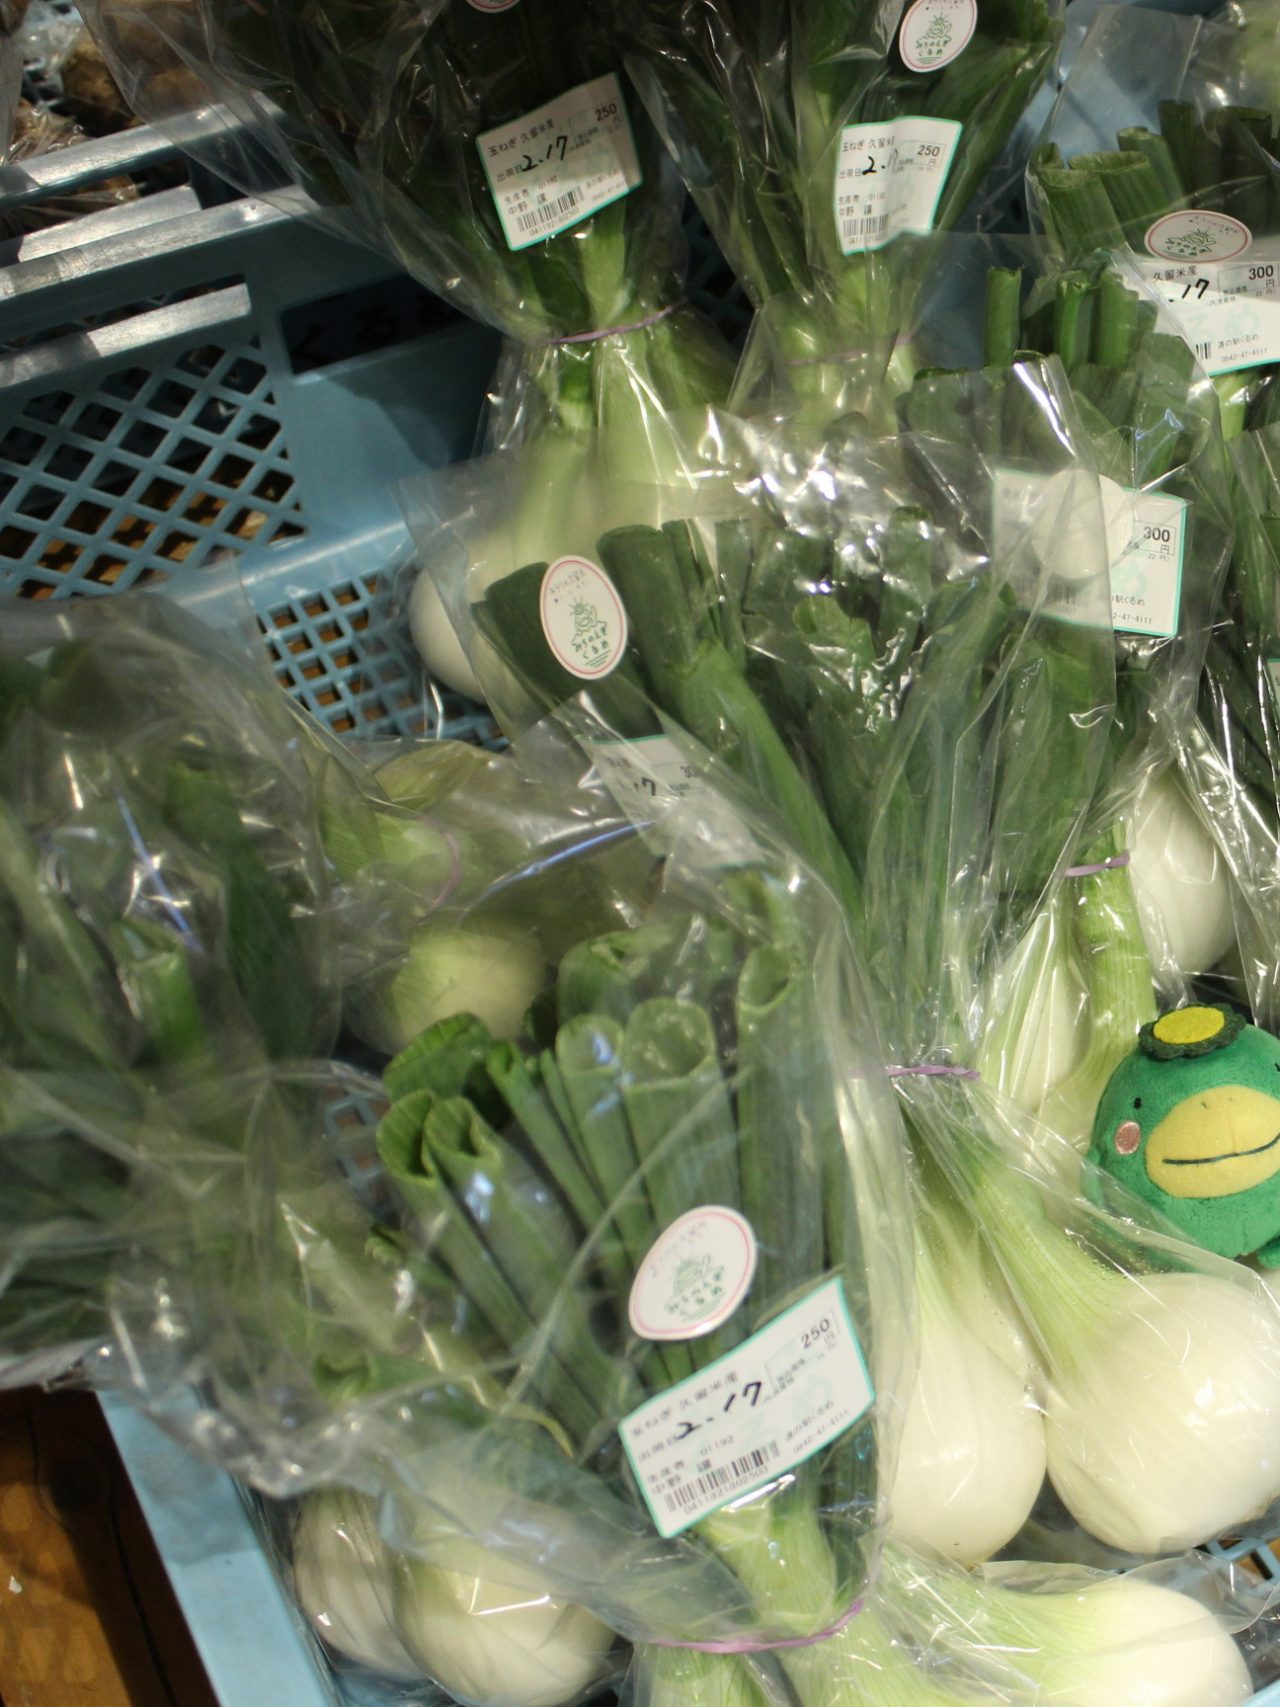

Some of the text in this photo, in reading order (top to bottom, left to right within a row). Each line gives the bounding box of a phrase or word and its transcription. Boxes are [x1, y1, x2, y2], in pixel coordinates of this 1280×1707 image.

[595, 102, 618, 122] 250
[488, 136, 517, 157] 玉ねぎ
[842, 140, 865, 152] 玉ねぎ
[917, 144, 940, 157] 250
[1153, 265, 1198, 281] 久留米産
[1249, 264, 1274, 281] 300
[1265, 279, 1276, 288] 円
[1143, 526, 1170, 543] 300
[1160, 544, 1170, 555] 円
[801, 1318, 830, 1349] 250
